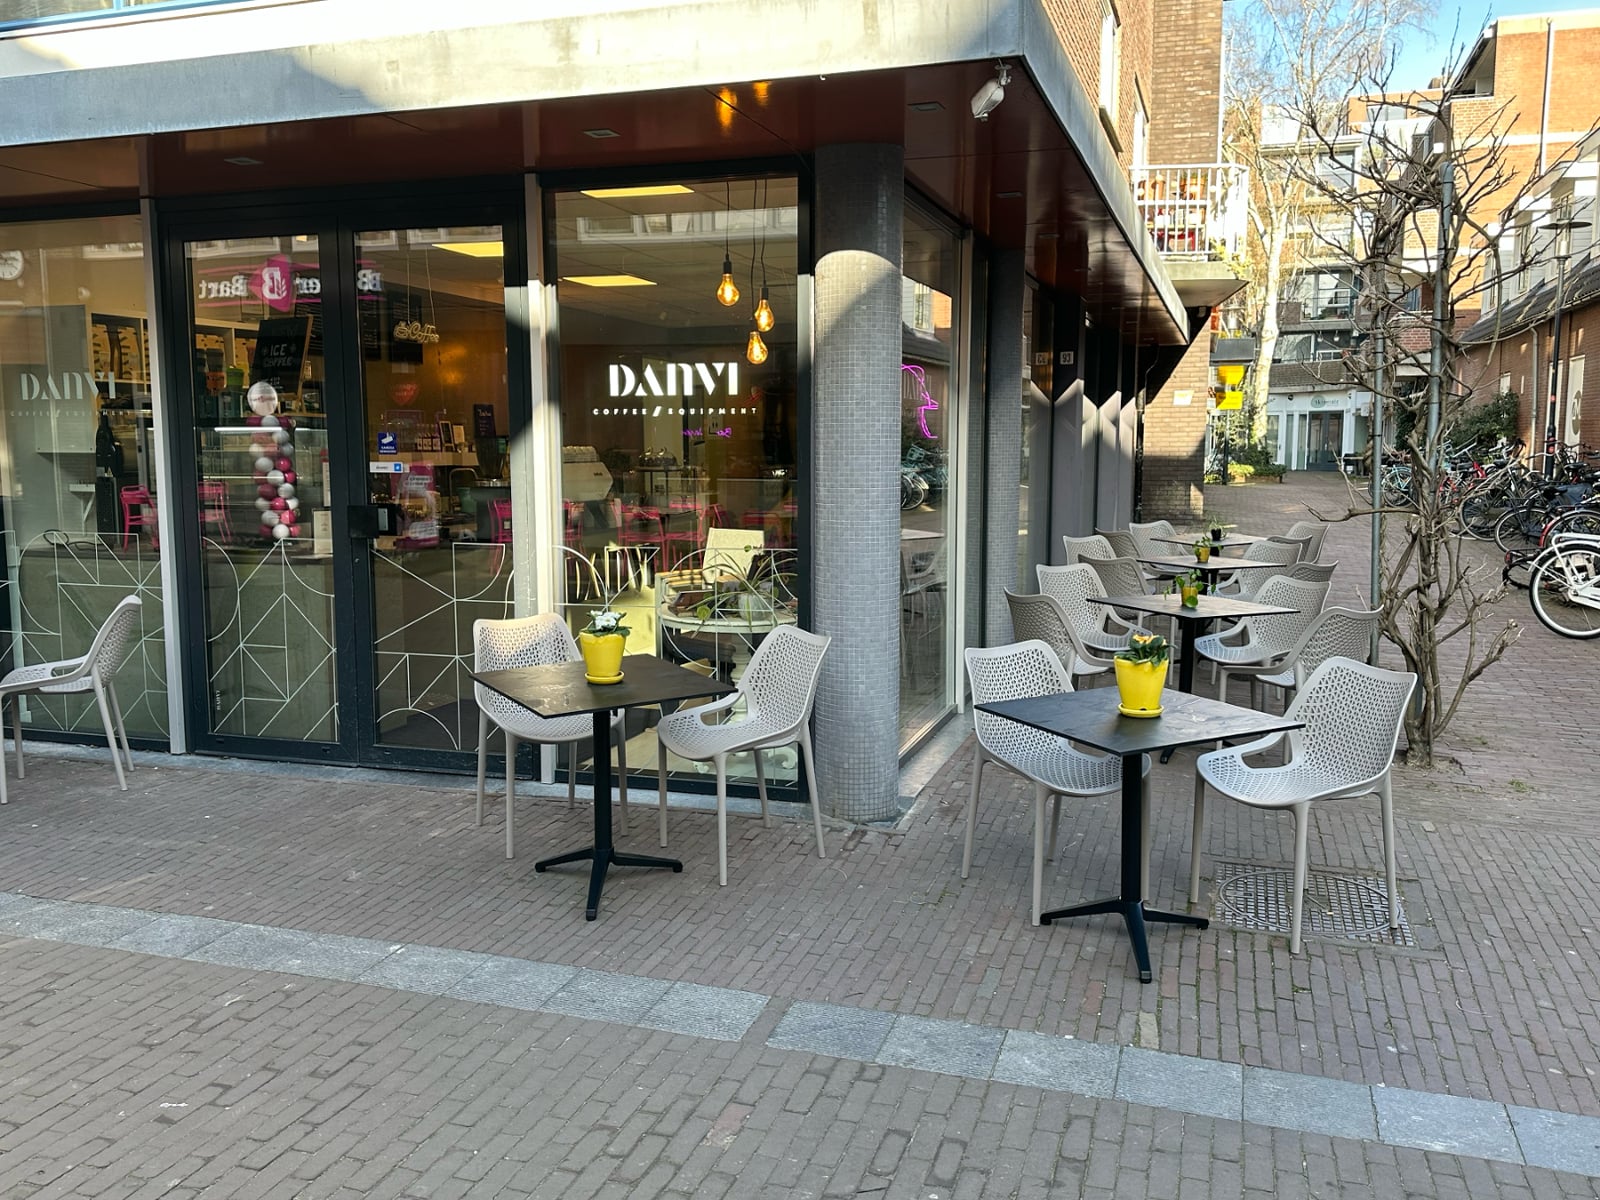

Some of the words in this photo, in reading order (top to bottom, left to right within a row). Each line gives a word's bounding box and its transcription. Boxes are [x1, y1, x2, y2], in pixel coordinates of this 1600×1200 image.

[270, 343, 288, 356] ICE
[592, 408, 648, 416] COFFEE
[667, 407, 757, 416] EQUIPMENT
